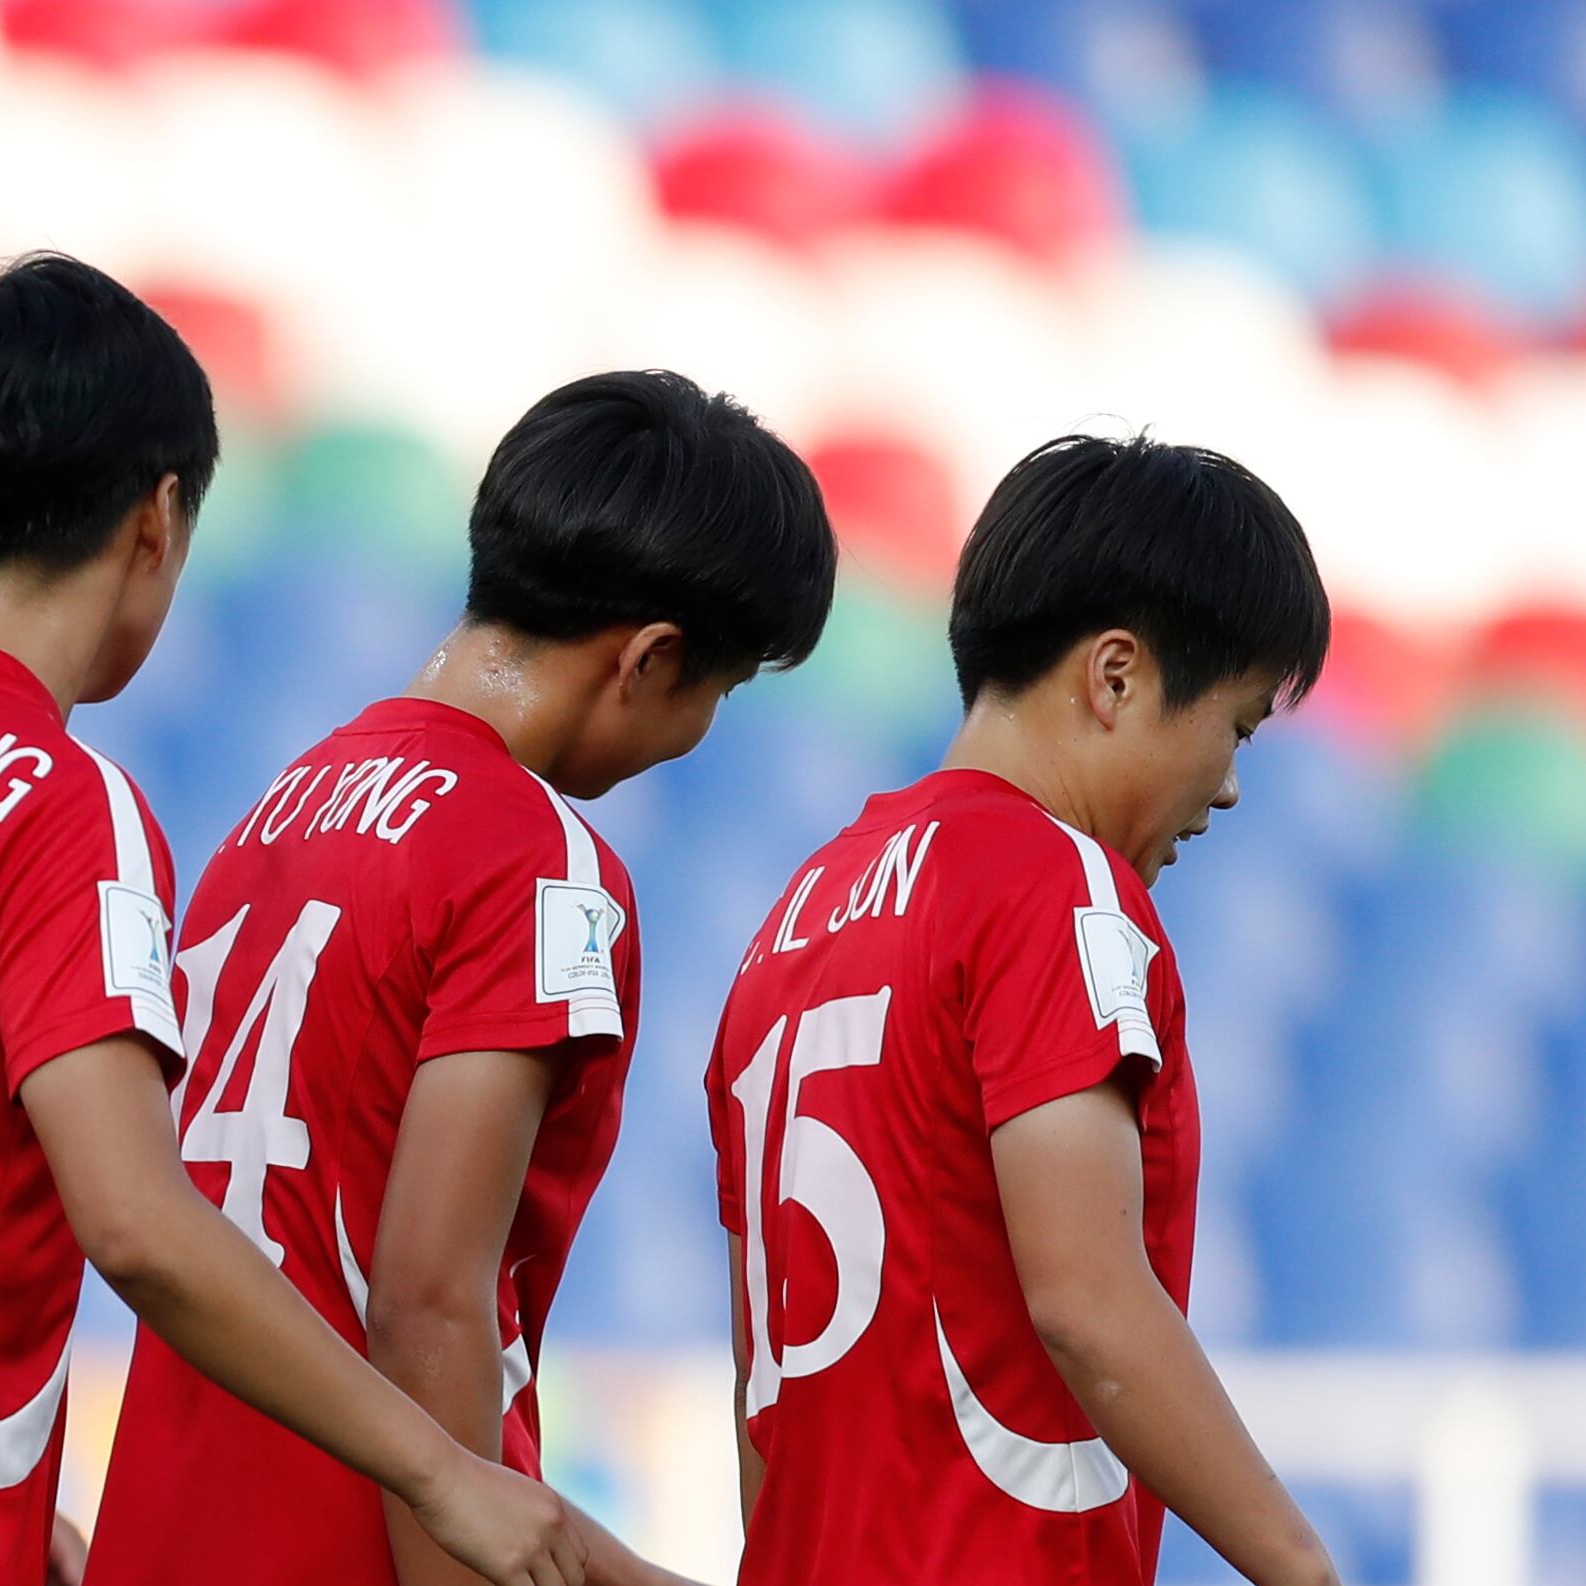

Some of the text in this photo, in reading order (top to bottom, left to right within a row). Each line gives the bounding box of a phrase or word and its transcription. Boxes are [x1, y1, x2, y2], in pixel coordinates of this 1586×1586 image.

[236, 765, 332, 847] YU
[772, 865, 826, 954] IL
[170, 900, 342, 1269] 14
[731, 984, 892, 1419] 15
